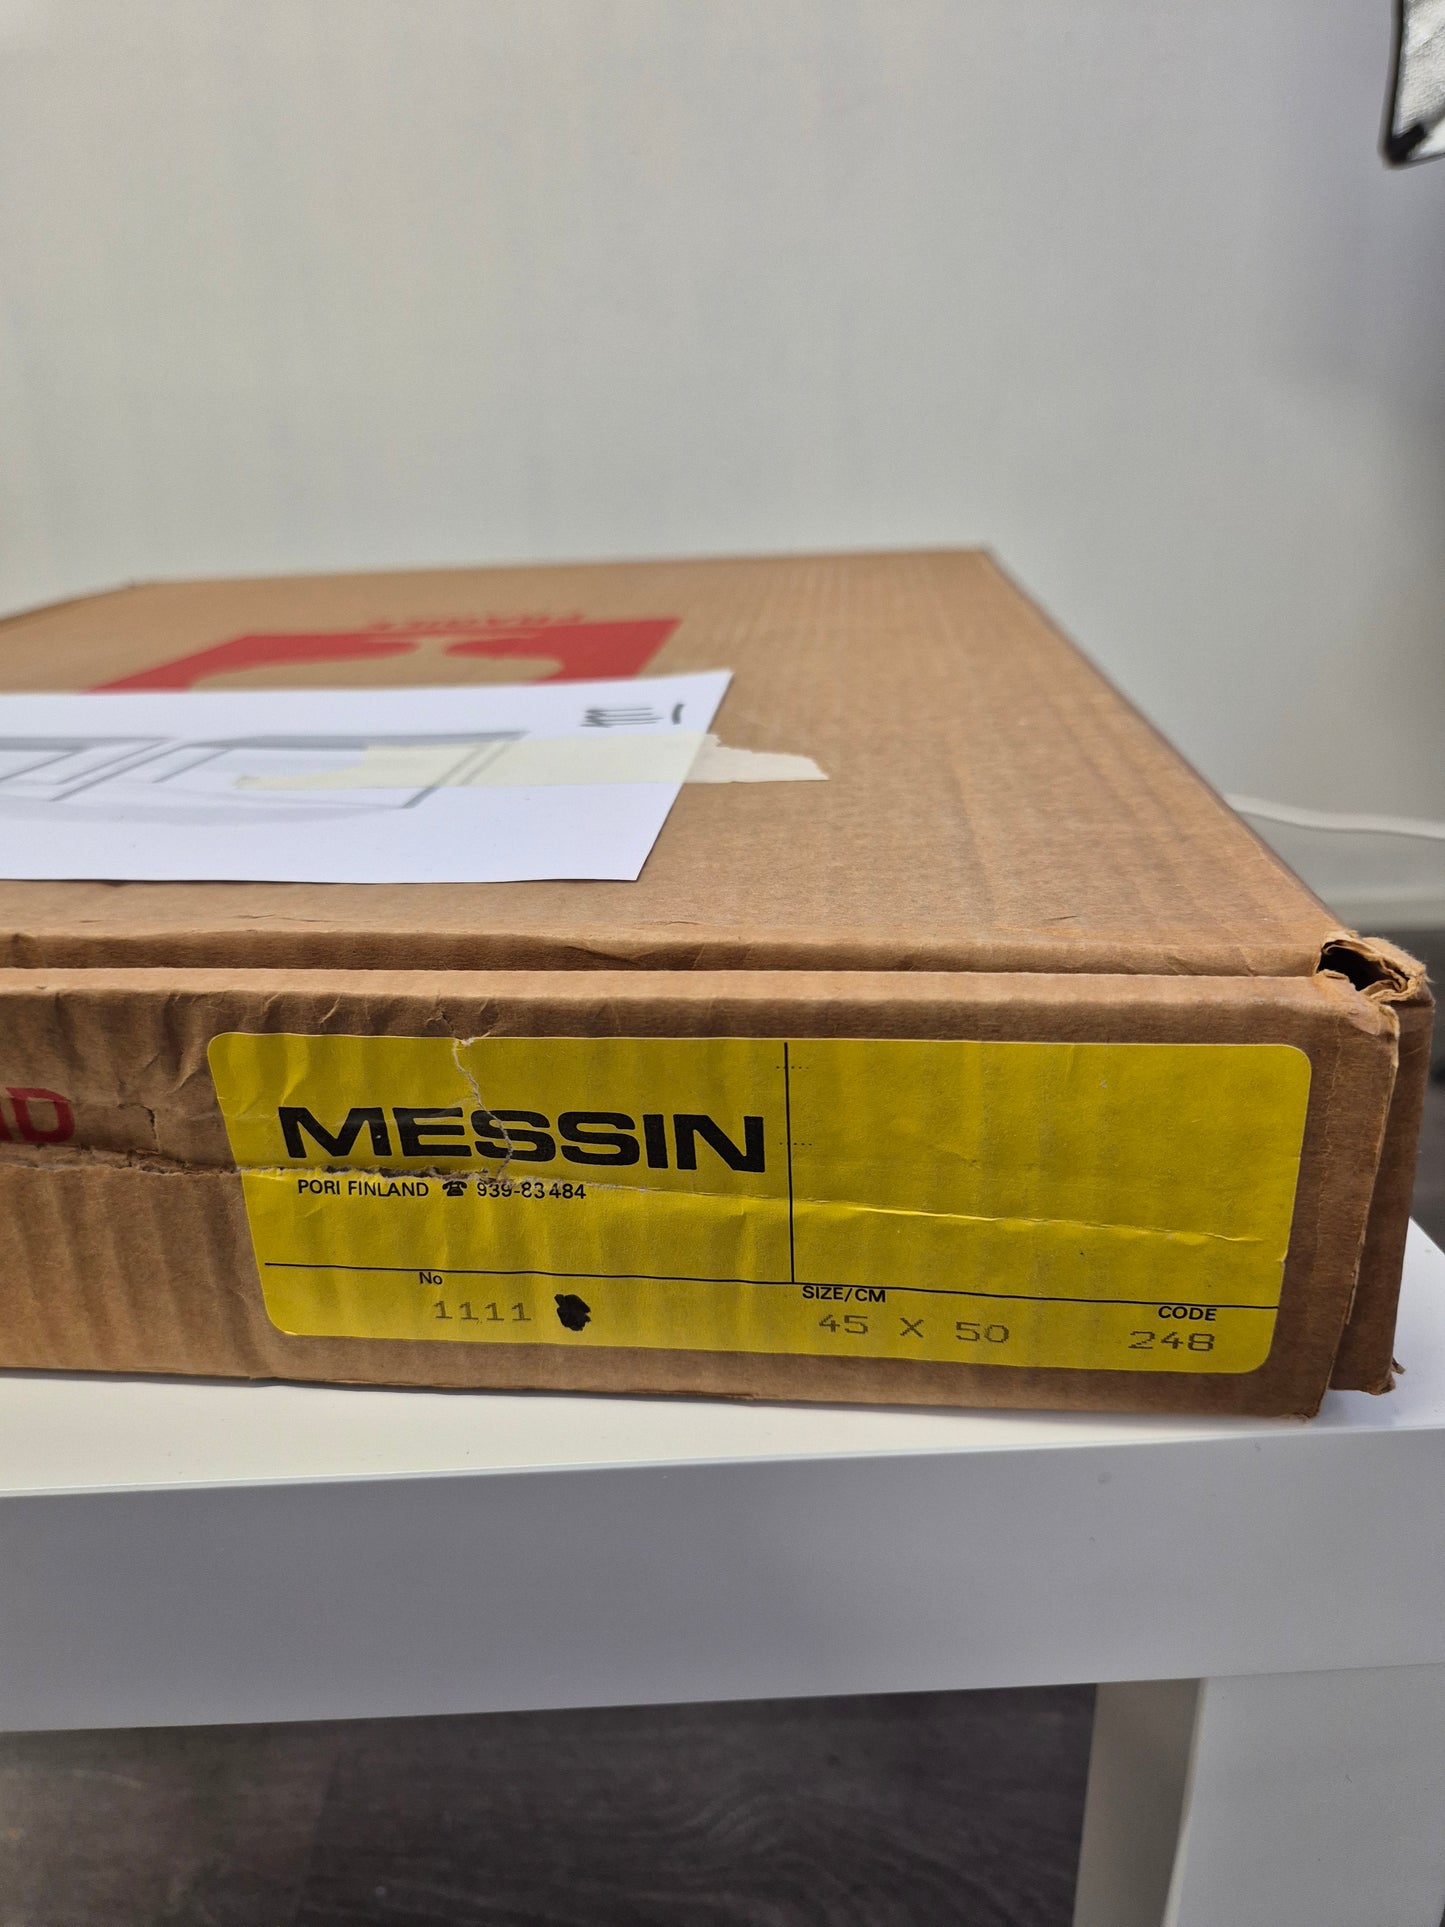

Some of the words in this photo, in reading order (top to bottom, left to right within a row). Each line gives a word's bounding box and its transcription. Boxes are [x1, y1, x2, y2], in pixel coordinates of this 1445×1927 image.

[278, 1106, 766, 1174] MESSIN
[297, 1178, 341, 1196] PORI
[347, 1179, 430, 1198] FINLAND
[419, 1271, 443, 1286] No
[801, 1284, 887, 1304] SIZE/CM
[433, 1300, 533, 1323] 1111
[1157, 1304, 1217, 1323] CODE
[818, 1313, 870, 1336] 45
[955, 1320, 1010, 1345] 50
[1128, 1330, 1216, 1353] 248
